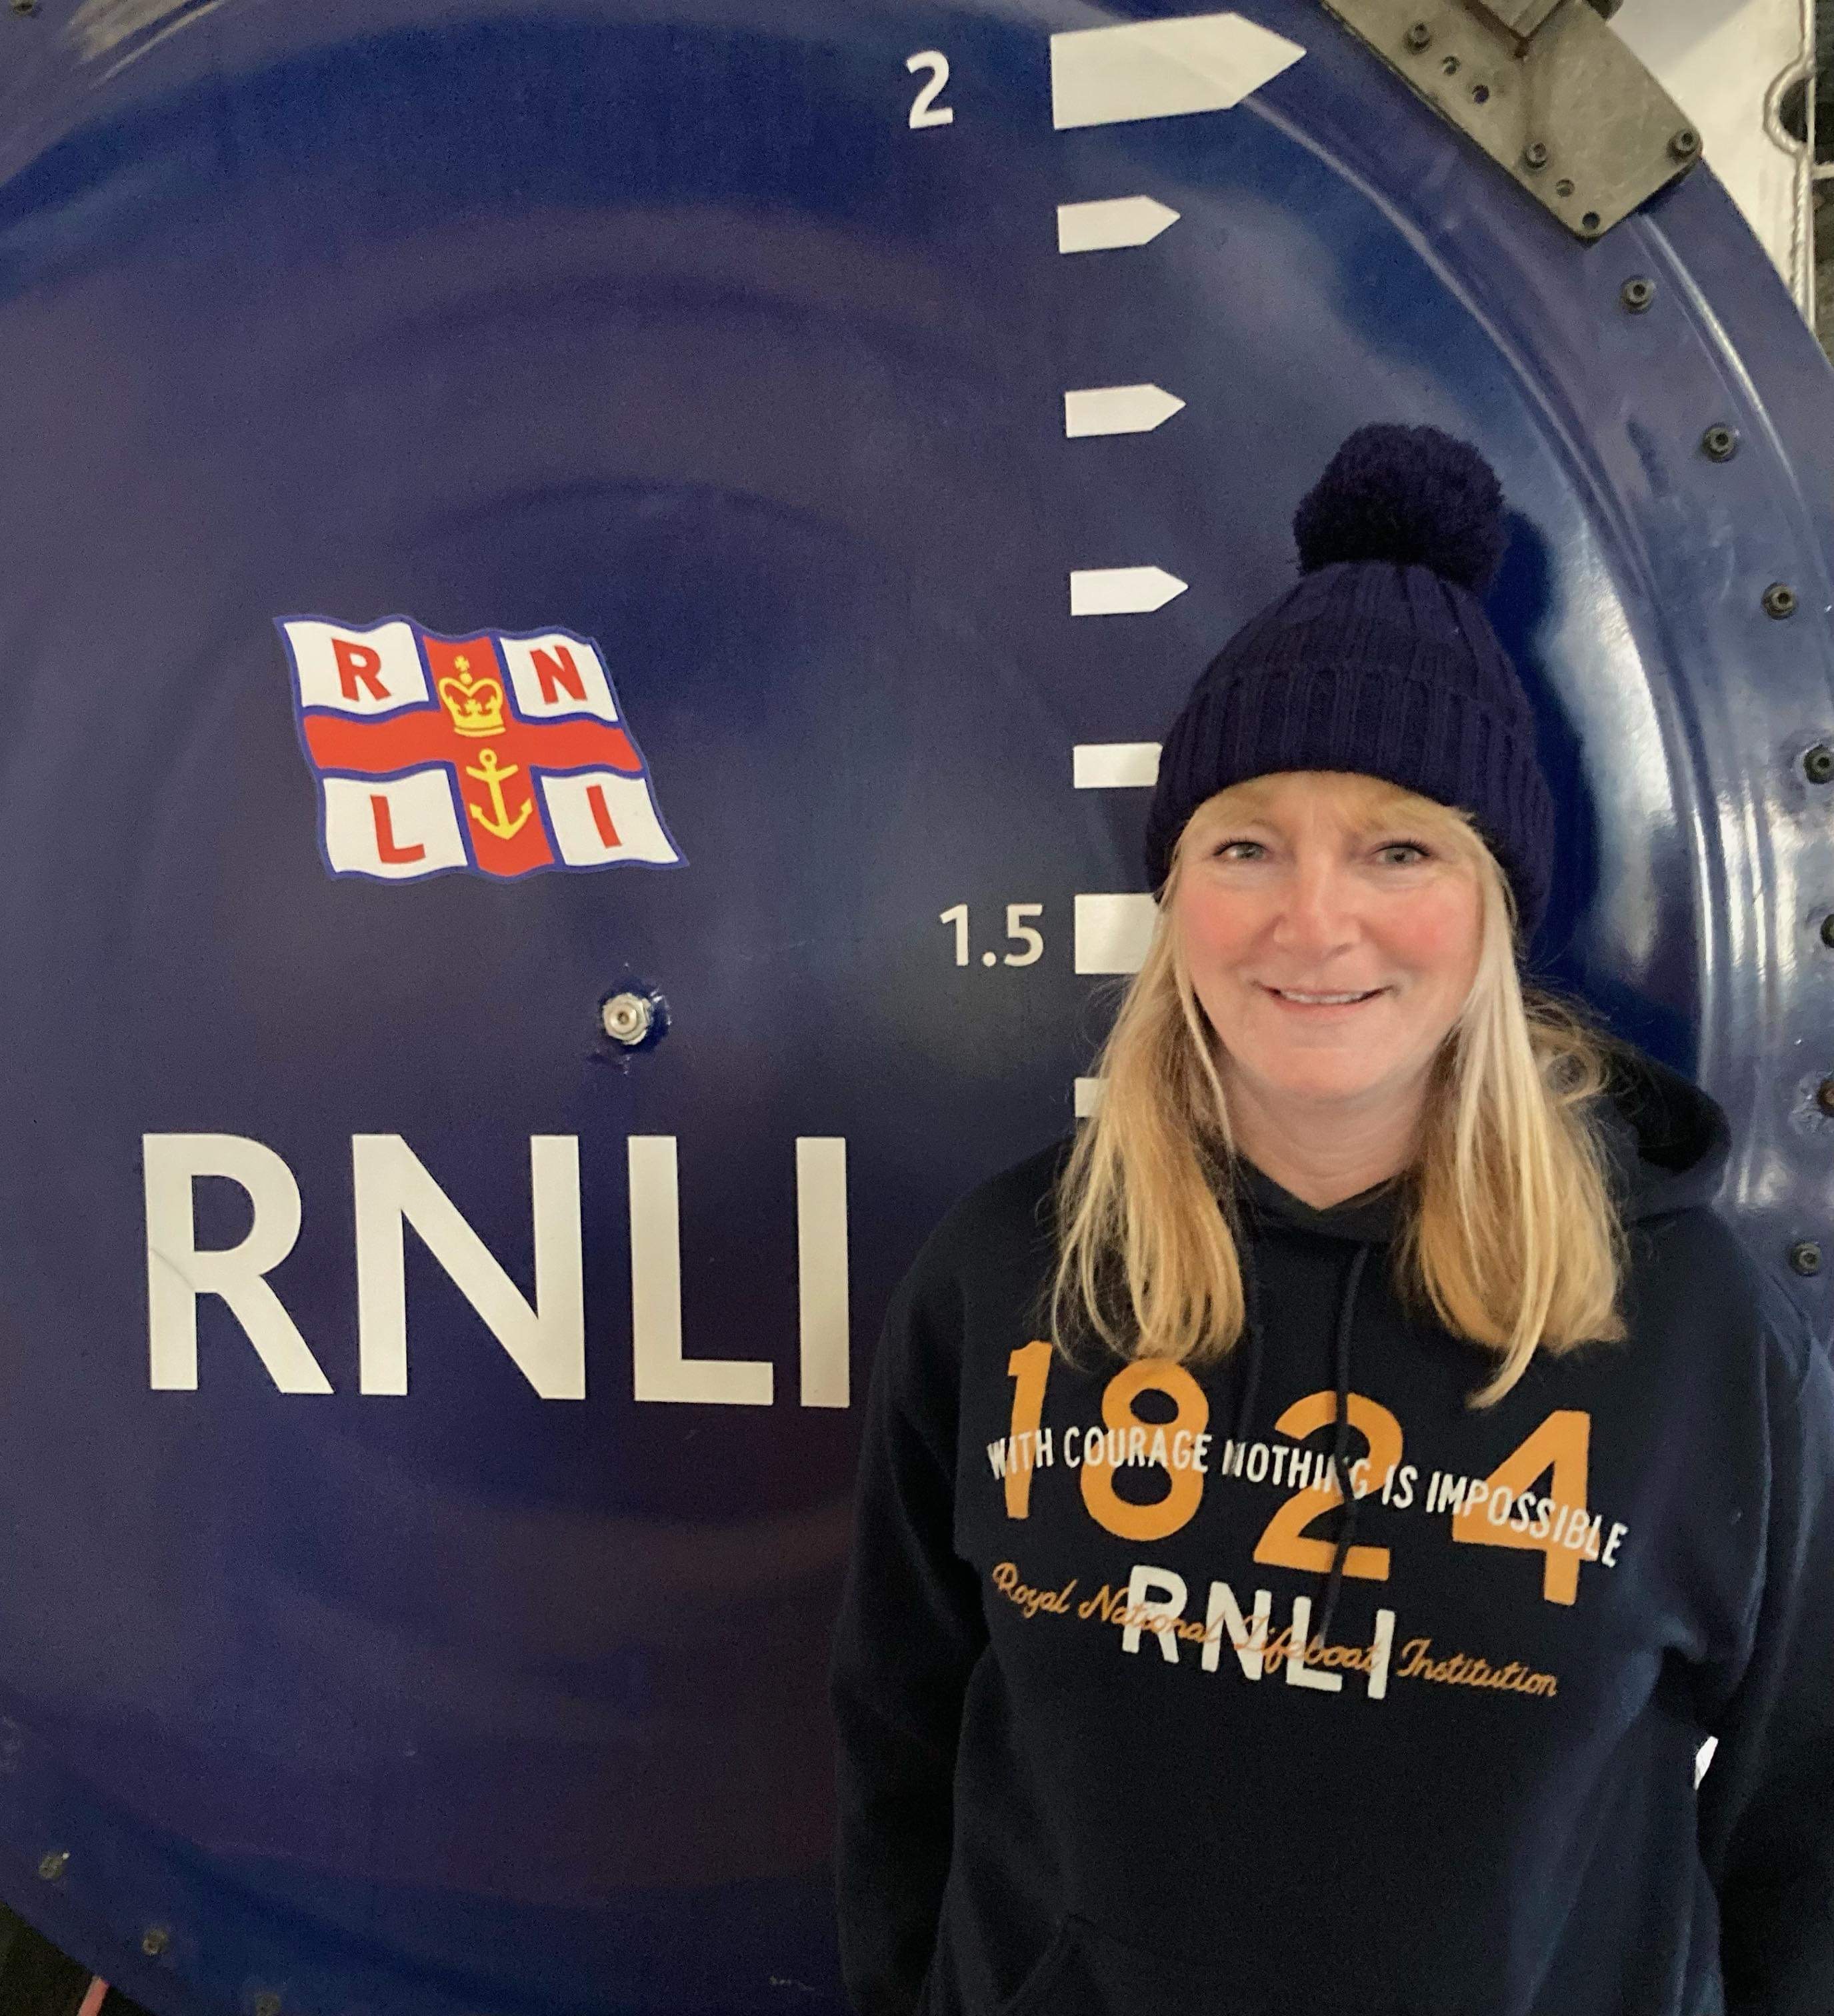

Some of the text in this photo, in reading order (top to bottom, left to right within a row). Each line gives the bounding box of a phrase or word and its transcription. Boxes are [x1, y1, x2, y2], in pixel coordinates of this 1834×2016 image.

[905, 50, 953, 129] 2
[331, 638, 587, 705] R N
[370, 783, 622, 864] L I
[939, 903, 1044, 968] 1.5
[141, 1133, 850, 1408] RNLI
[986, 1425, 1054, 1480] WITH
[1064, 1425, 1212, 1474] COURAGE
[1381, 1464, 1419, 1509] IS
[1425, 1472, 1629, 1569] IMPOSSIBLE
[1007, 1339, 1591, 1606] 1824
[992, 1561, 1557, 1698] Royal National Lifeboat Institution
[1122, 1565, 1395, 1700] RNLI
